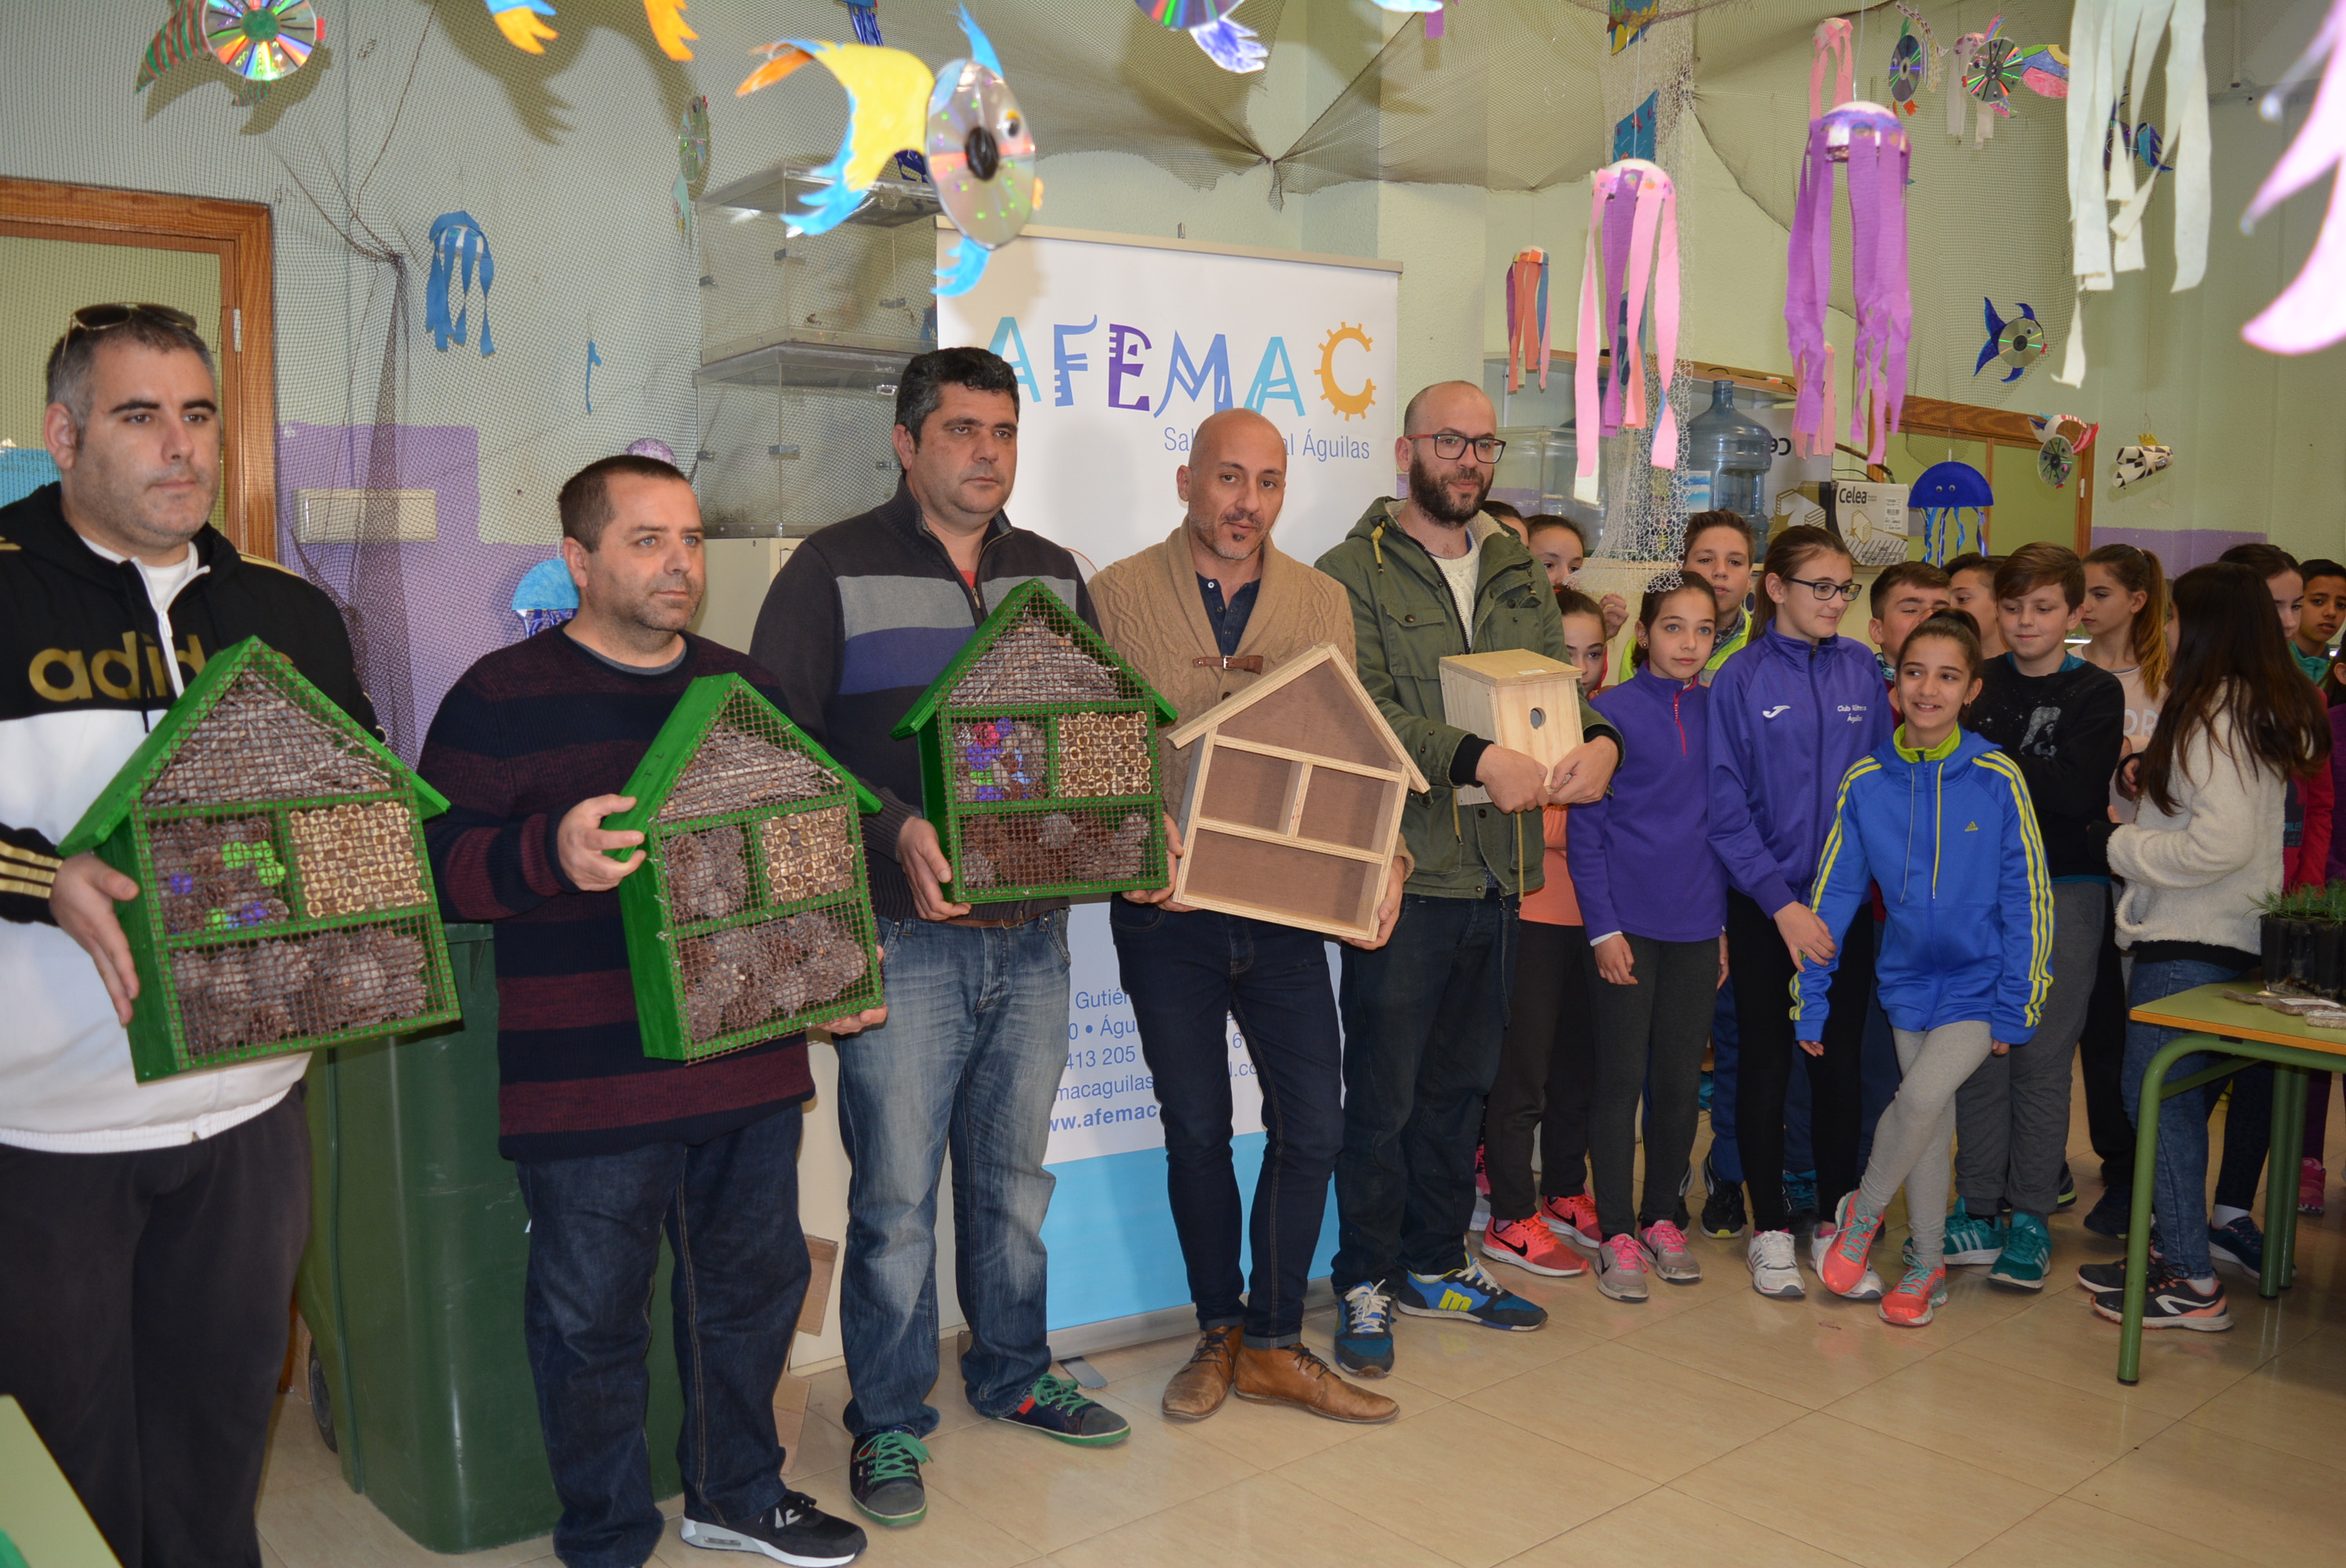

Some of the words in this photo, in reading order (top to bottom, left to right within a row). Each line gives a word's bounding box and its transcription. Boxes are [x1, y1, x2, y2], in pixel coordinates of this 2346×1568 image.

[988, 314, 1376, 421] AFEMAC
[1164, 427, 1194, 451] Sal
[1302, 429, 1370, 462] Águilas
[1839, 486, 1867, 503] Celea
[29, 631, 207, 702] adid
[2123, 709, 2159, 737] OR
[1076, 987, 1129, 1009] Gutiér
[1102, 1045, 1136, 1065] 205
[1057, 1074, 1153, 1101] macaguilas
[1050, 1105, 1157, 1132] ww.afemac
